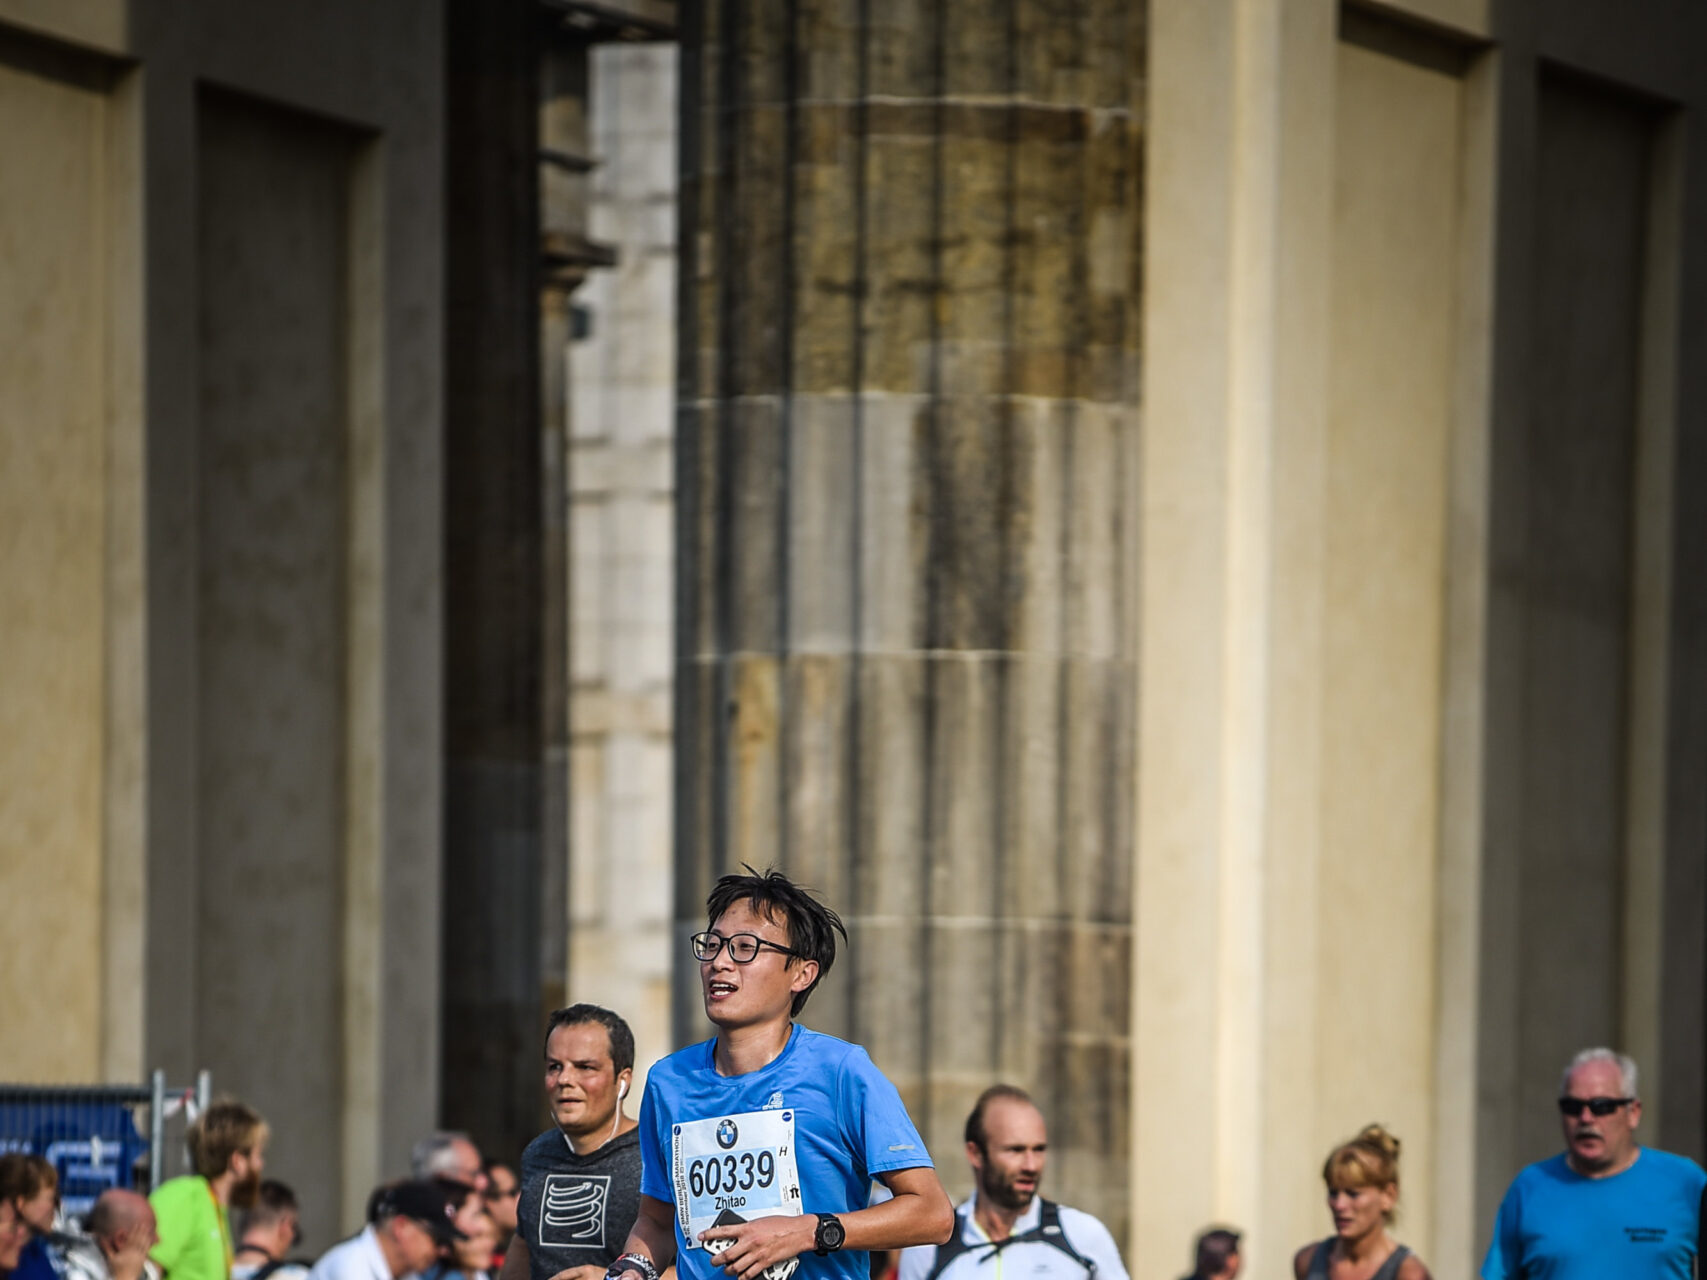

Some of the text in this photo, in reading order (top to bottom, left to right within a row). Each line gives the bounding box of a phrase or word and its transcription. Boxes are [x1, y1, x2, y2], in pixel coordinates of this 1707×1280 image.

[779, 1146, 788, 1157] H
[689, 1151, 774, 1198] 60339
[715, 1196, 747, 1210] Zhitao
